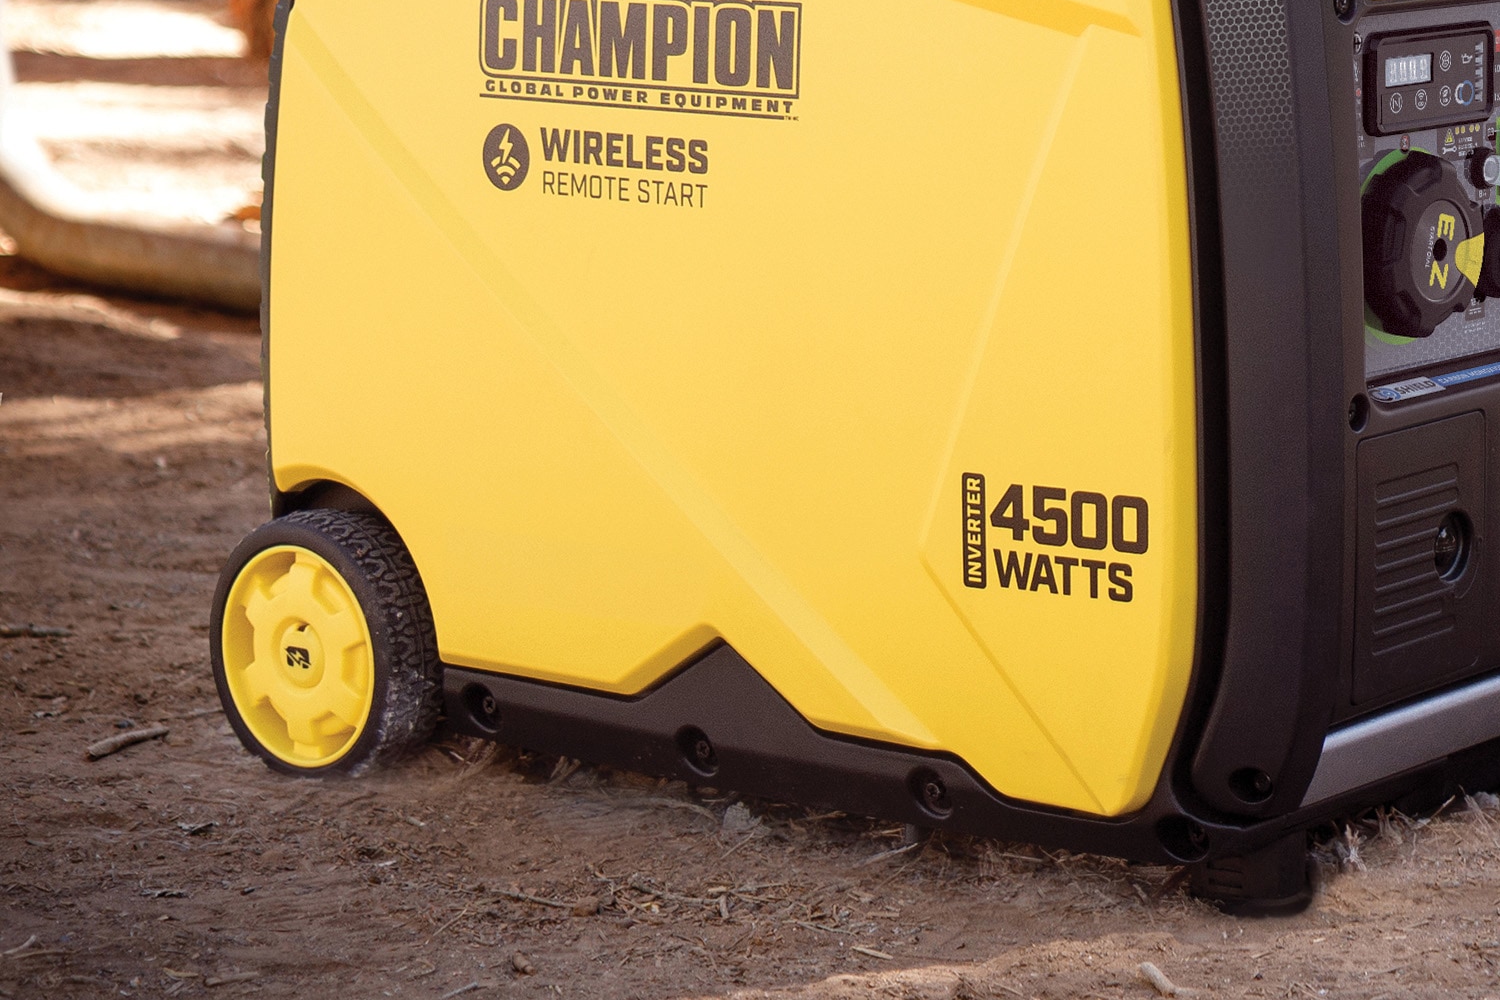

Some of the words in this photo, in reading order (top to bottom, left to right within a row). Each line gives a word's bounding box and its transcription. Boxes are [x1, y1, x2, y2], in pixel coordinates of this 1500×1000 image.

[485, 79, 564, 98] GLOBAL
[572, 83, 648, 104] POWER
[660, 91, 794, 114] EQUIPMENT
[539, 126, 709, 175] WIRELESS
[542, 170, 630, 202] REMOTE
[637, 178, 709, 209] START
[1394, 380, 1436, 395] SHIELD
[965, 476, 983, 583] INVERTER
[989, 483, 1149, 555] 4500
[992, 548, 1134, 603] WATTS
